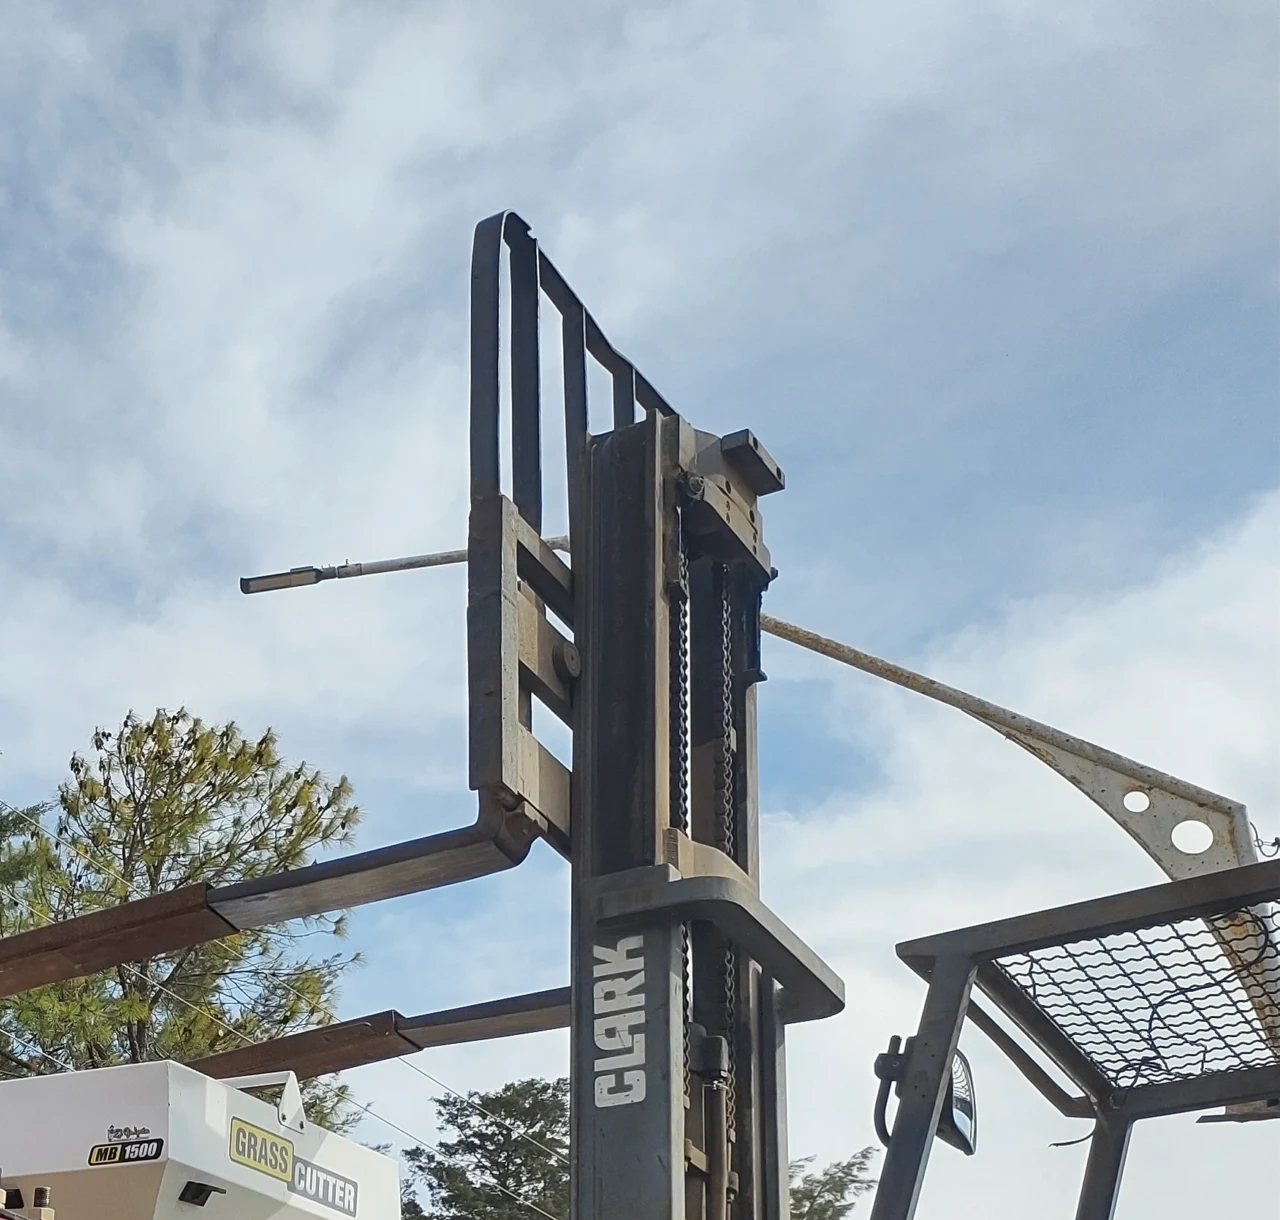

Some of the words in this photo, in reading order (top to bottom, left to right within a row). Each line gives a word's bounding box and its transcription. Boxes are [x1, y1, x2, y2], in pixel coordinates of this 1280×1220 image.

[593, 935, 646, 1109] CLARK
[95, 1147, 119, 1162] MB
[124, 1142, 158, 1160] 1500
[235, 1127, 289, 1174] GRASS
[294, 1162, 356, 1213] CUTTER
